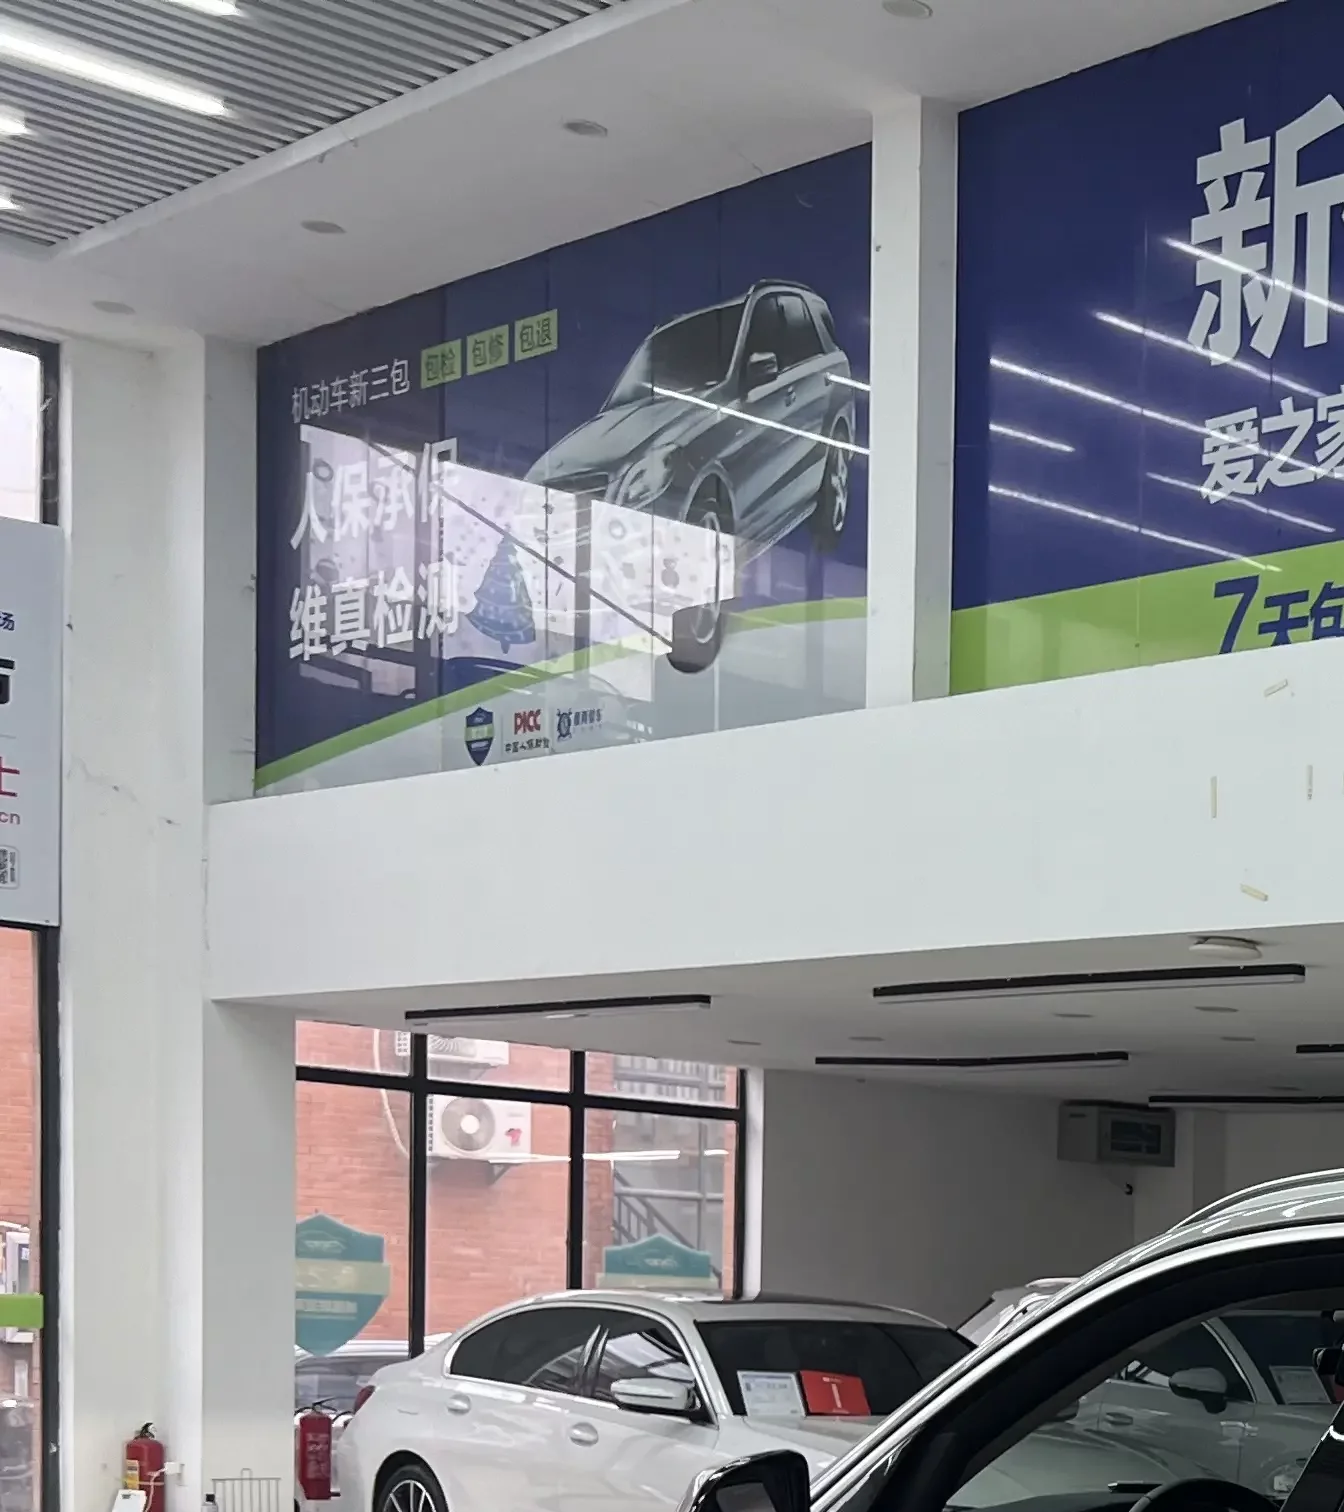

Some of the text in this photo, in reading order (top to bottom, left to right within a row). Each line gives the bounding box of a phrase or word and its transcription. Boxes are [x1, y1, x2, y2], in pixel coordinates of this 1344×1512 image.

[425, 317, 557, 382] 包检 包修 包退
[291, 358, 410, 423] 机动车新三包
[290, 437, 458, 550] 人保承保
[290, 564, 460, 661] 维真检测
[514, 709, 541, 735] PICC
